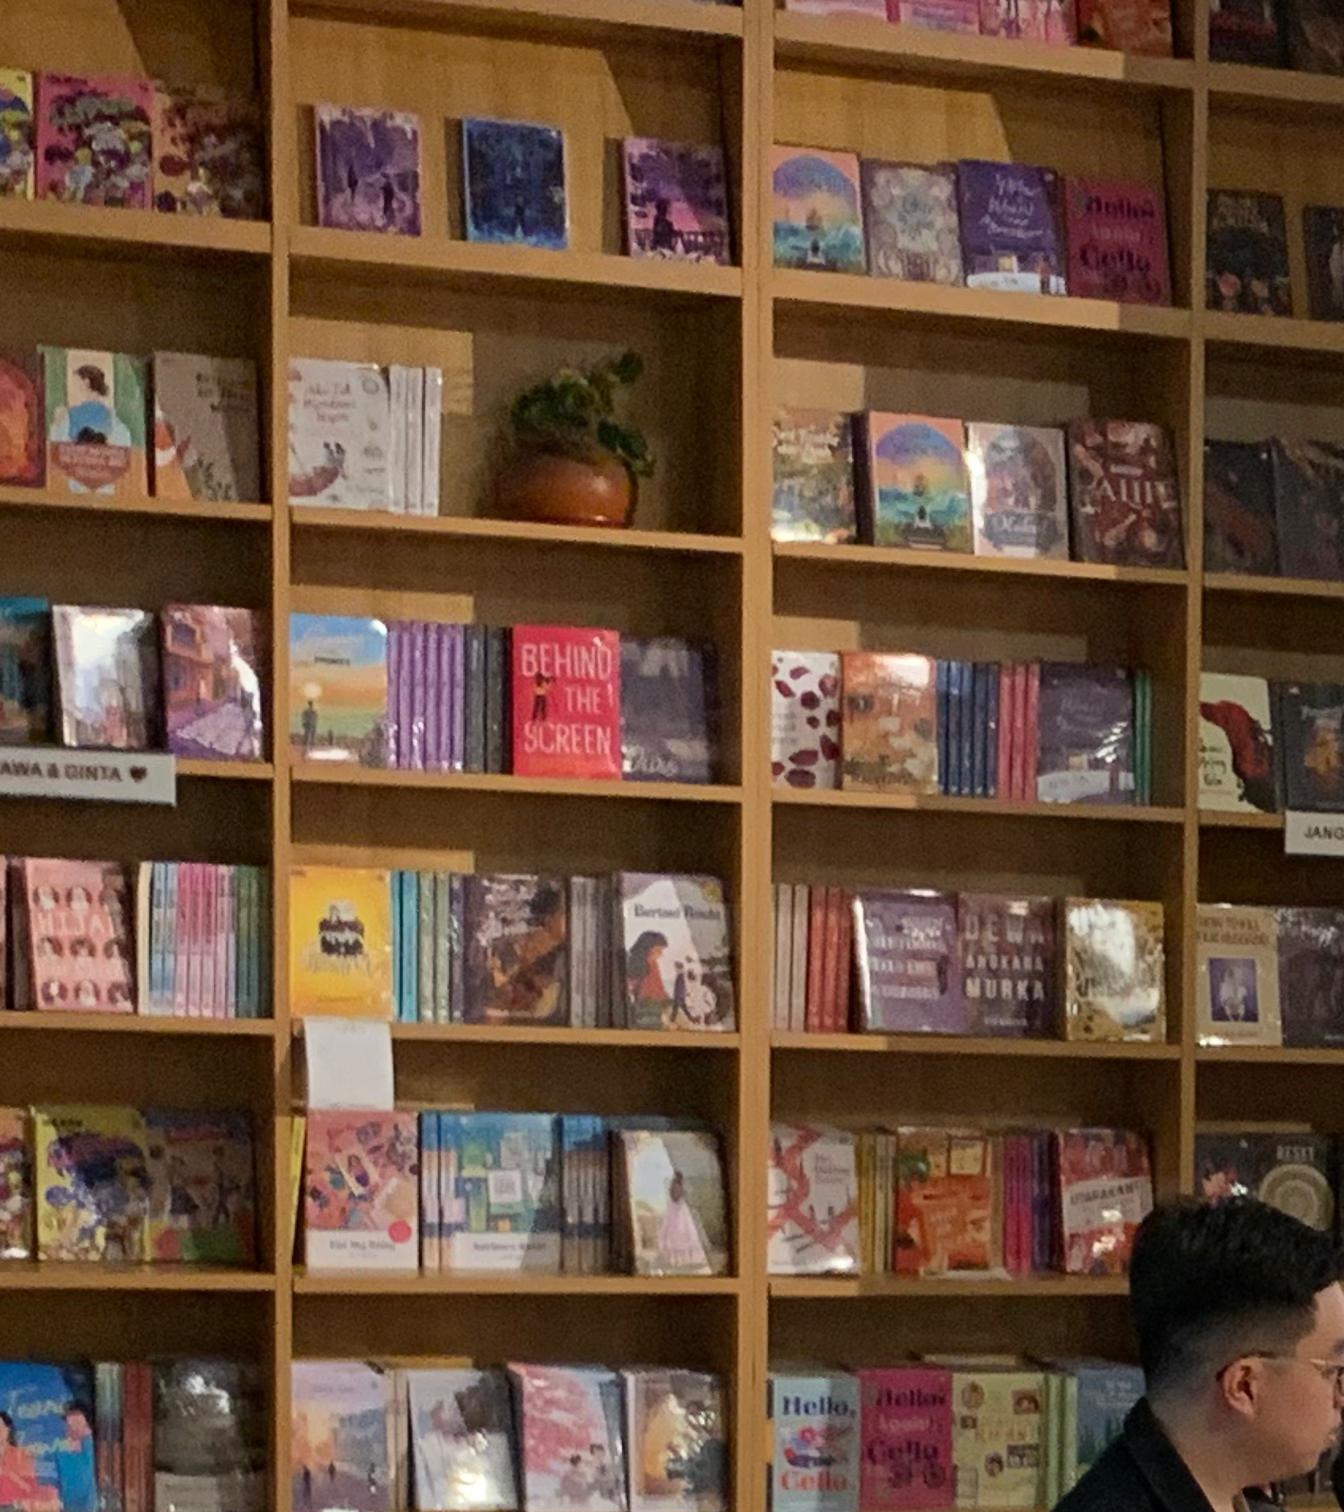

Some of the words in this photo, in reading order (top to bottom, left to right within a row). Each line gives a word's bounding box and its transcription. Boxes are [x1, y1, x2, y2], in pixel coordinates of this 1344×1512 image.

[521, 645, 613, 678] BEHIND
[564, 686, 602, 713] THE
[523, 721, 613, 757] SCREEN
[781, 1394, 855, 1420] Hello,
[779, 1468, 849, 1494] Cello
